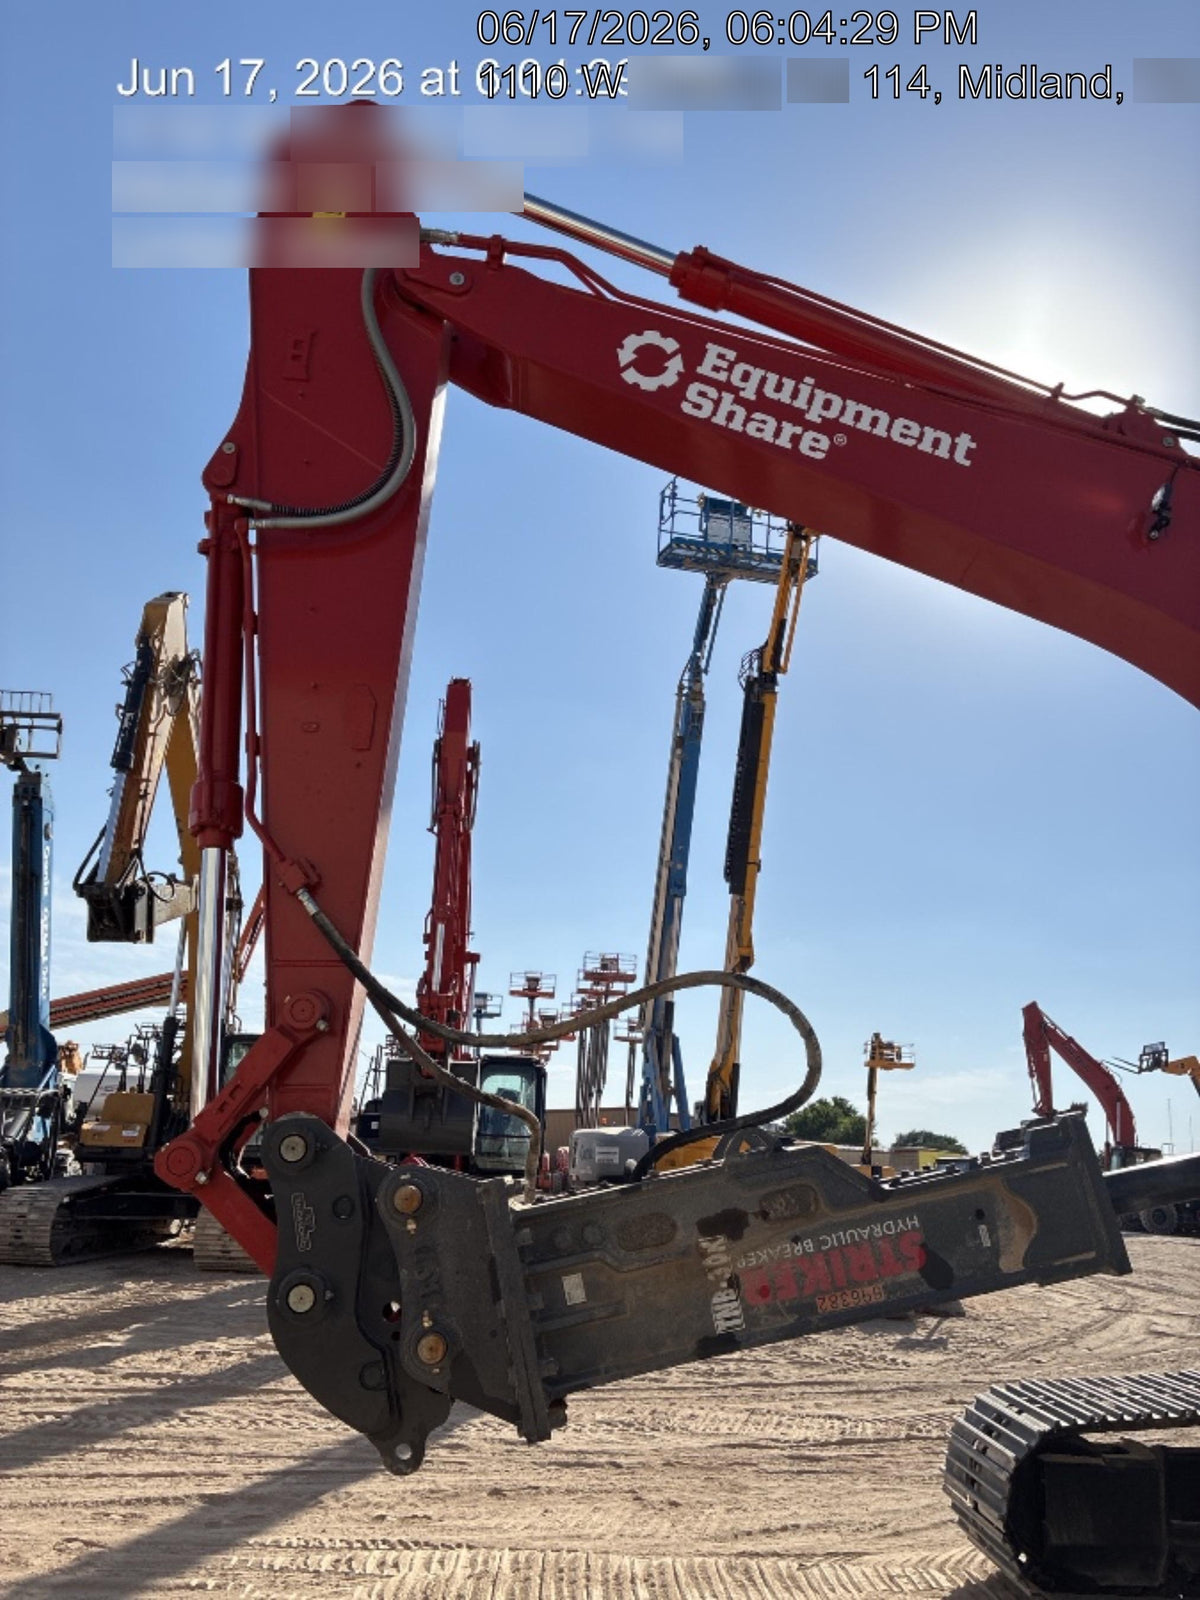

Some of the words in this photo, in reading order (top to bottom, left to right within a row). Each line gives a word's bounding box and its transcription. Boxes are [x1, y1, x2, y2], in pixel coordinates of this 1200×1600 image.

[680, 381, 831, 461] Share
[696, 342, 977, 468] Equipment
[740, 1231, 926, 1307] STRIKER
[819, 1215, 920, 1250] HYDRAULIC
